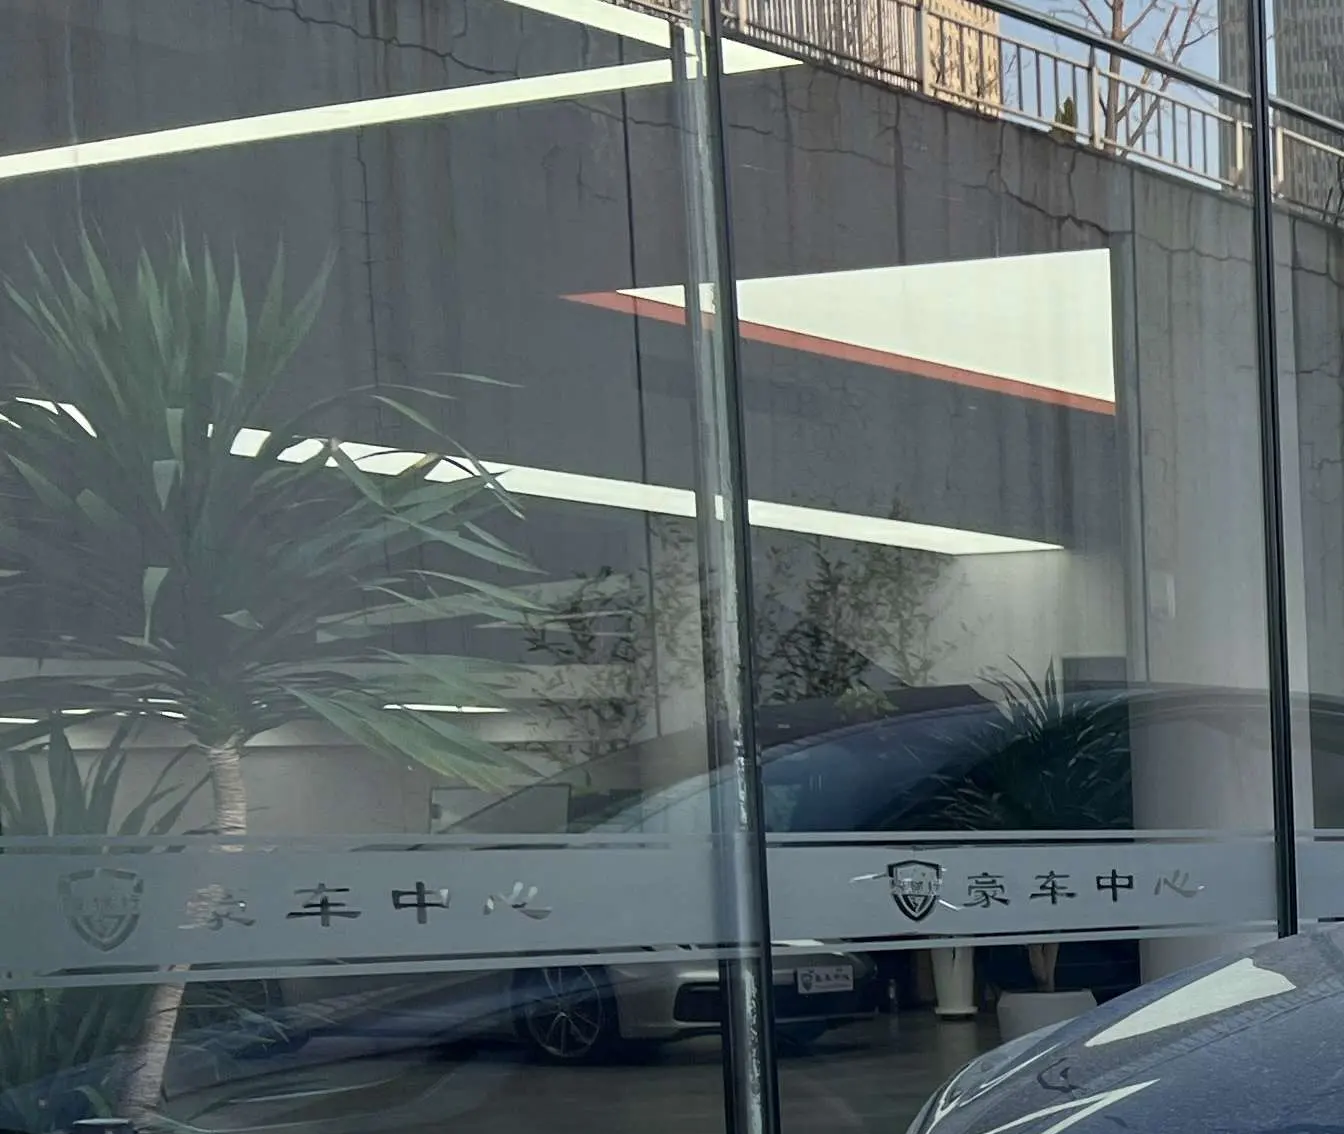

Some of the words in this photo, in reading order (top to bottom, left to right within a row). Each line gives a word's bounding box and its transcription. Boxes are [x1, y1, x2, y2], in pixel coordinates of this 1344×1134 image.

[178, 881, 552, 930] 豪车中心
[962, 869, 1199, 908] 豪车中心
